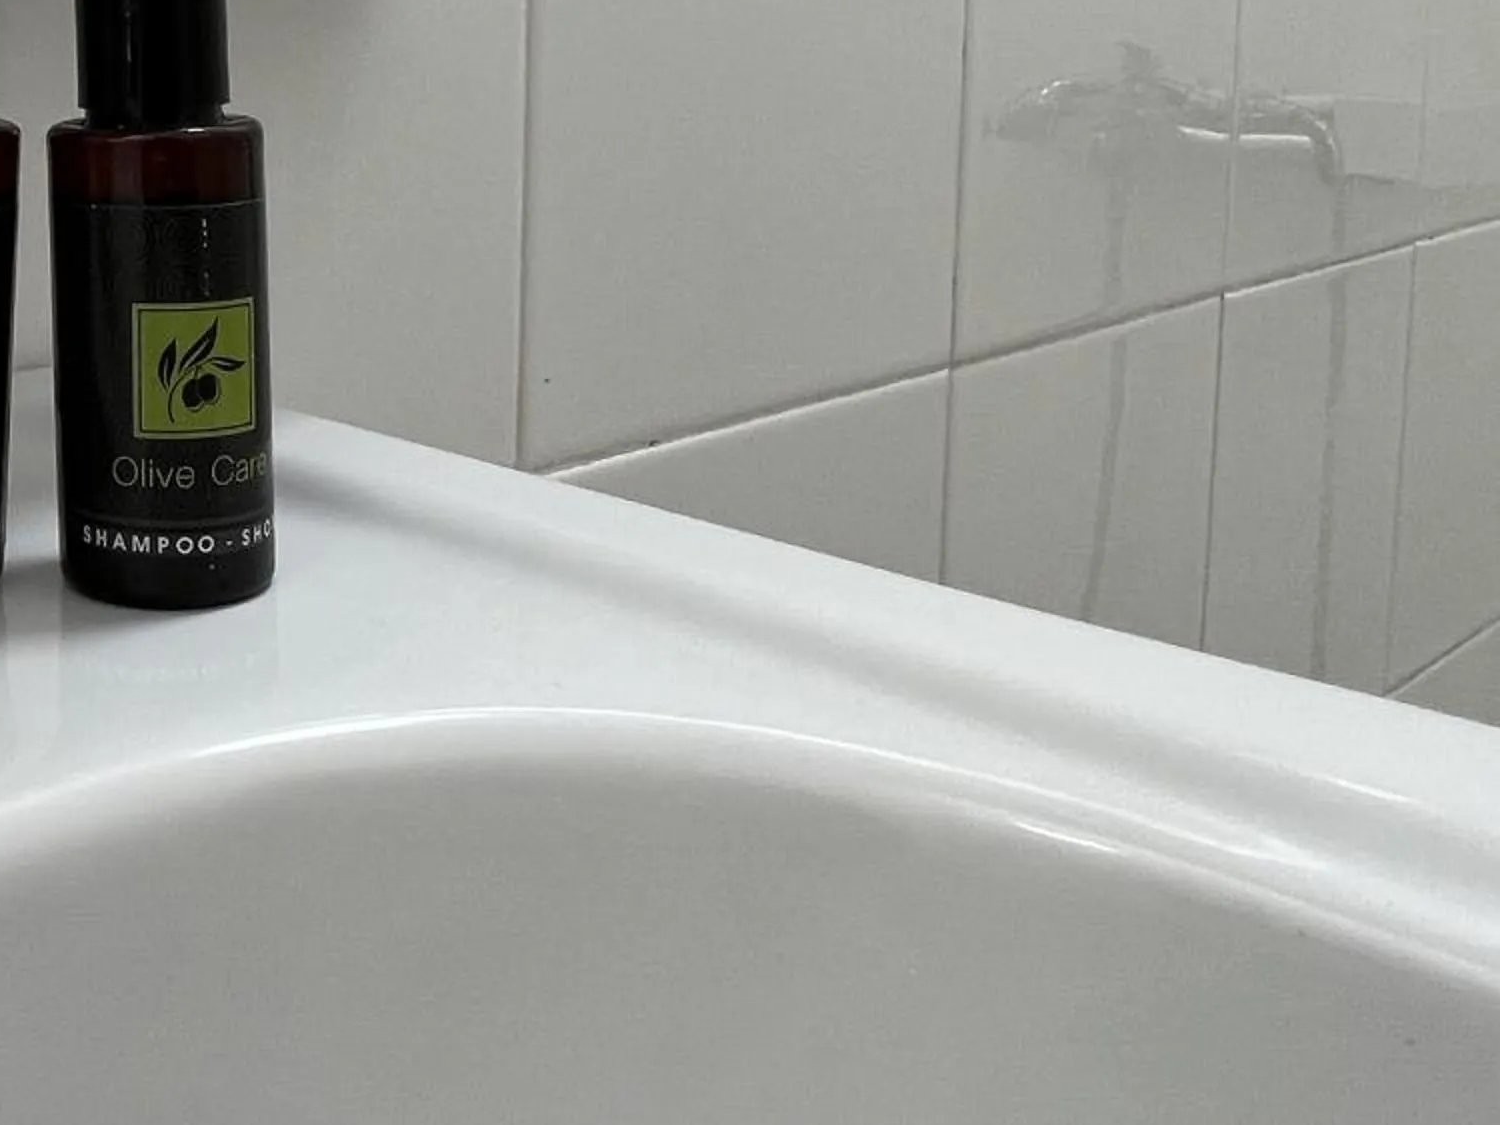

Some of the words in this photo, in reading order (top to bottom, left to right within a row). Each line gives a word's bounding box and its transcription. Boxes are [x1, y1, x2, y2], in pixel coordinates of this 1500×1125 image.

[112, 455, 196, 489] Olive
[211, 452, 267, 486] Care
[83, 525, 215, 555] SHAMPOO
